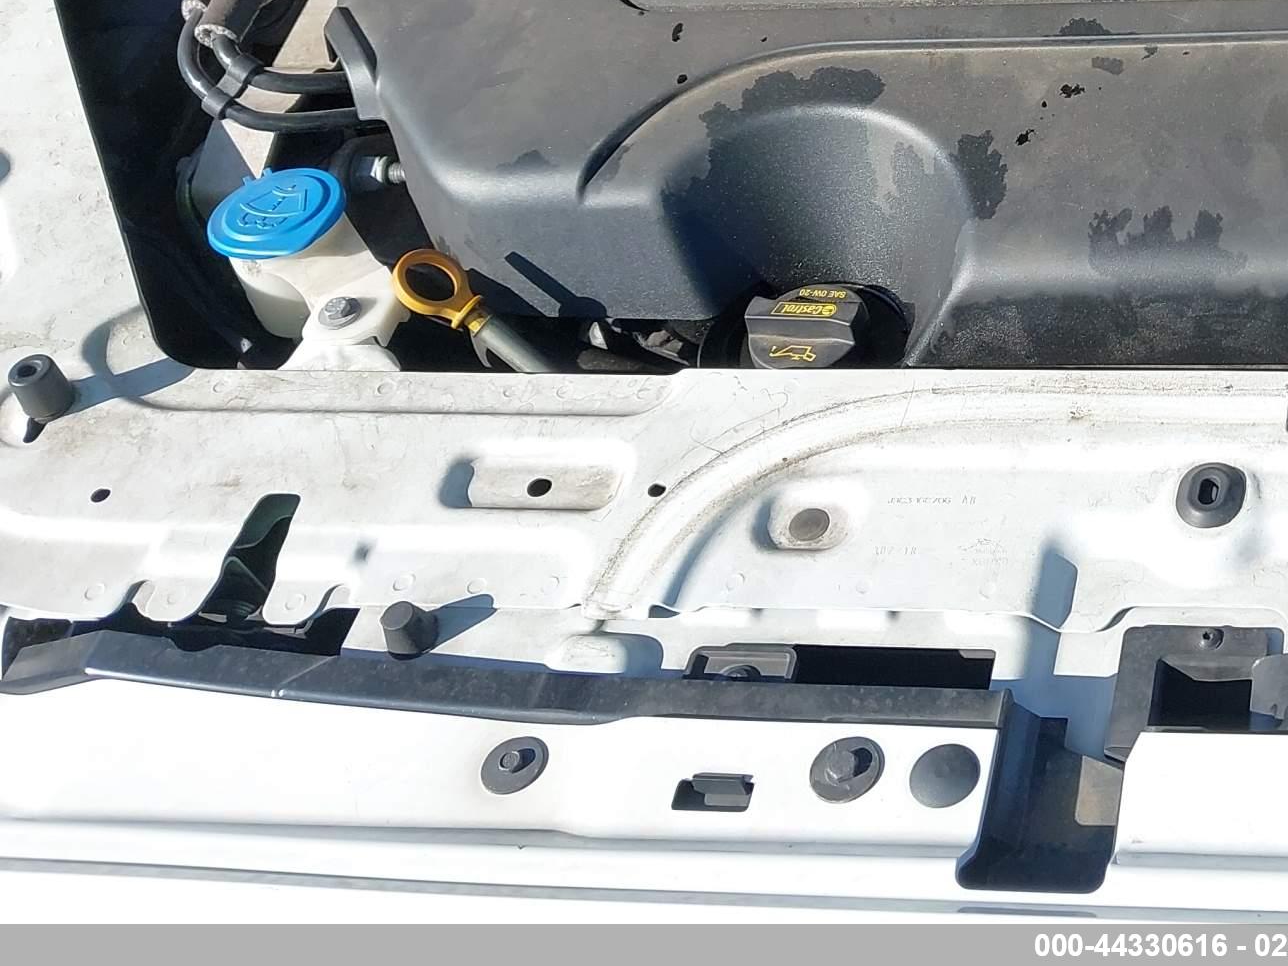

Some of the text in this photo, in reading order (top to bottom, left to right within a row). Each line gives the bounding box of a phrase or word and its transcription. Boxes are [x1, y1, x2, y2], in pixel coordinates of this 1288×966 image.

[800, 288, 847, 299] SAE 0W-20
[781, 304, 823, 315] Castrol
